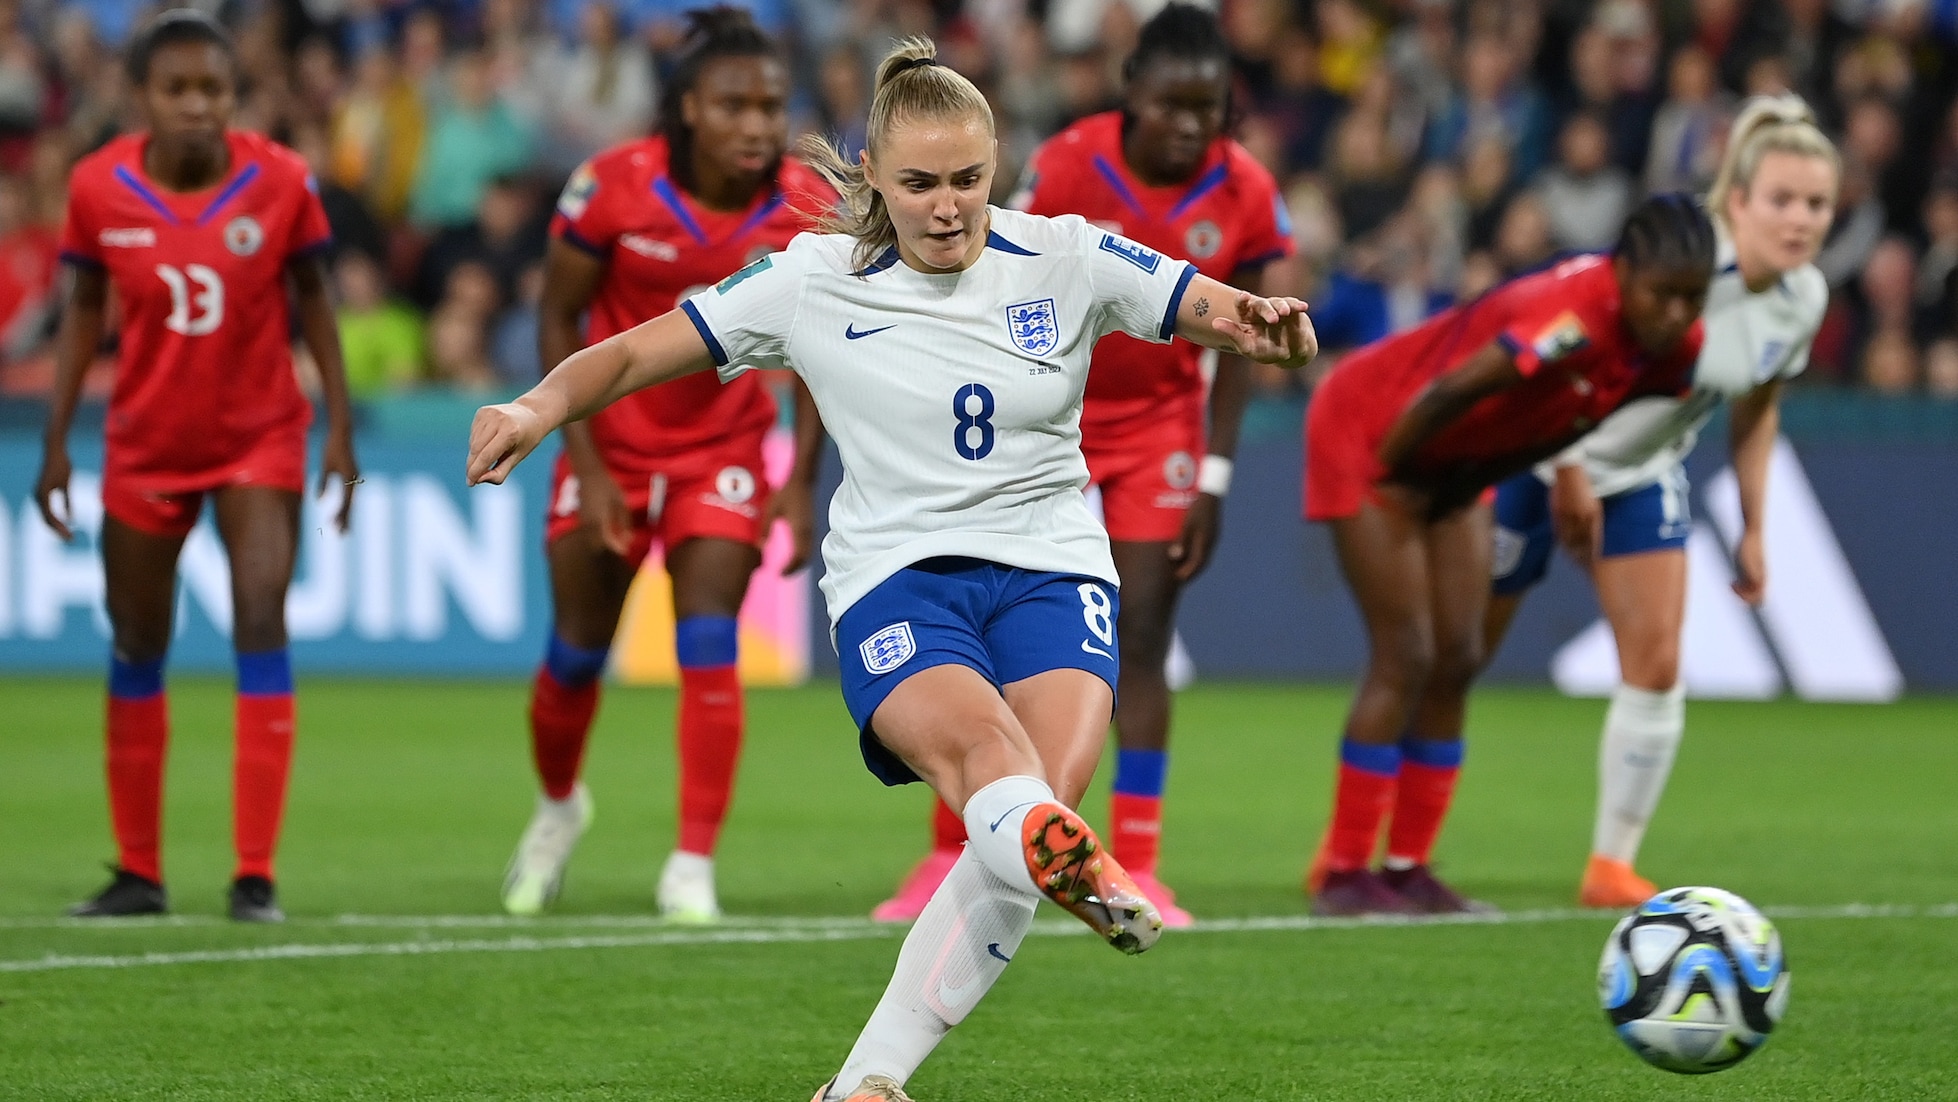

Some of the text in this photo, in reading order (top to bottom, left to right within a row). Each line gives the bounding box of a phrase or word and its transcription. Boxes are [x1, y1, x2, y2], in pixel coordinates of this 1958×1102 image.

[155, 263, 223, 336] 13
[953, 383, 995, 461] 8
[0, 470, 524, 641] AJIN
[1077, 582, 1113, 646] 8
